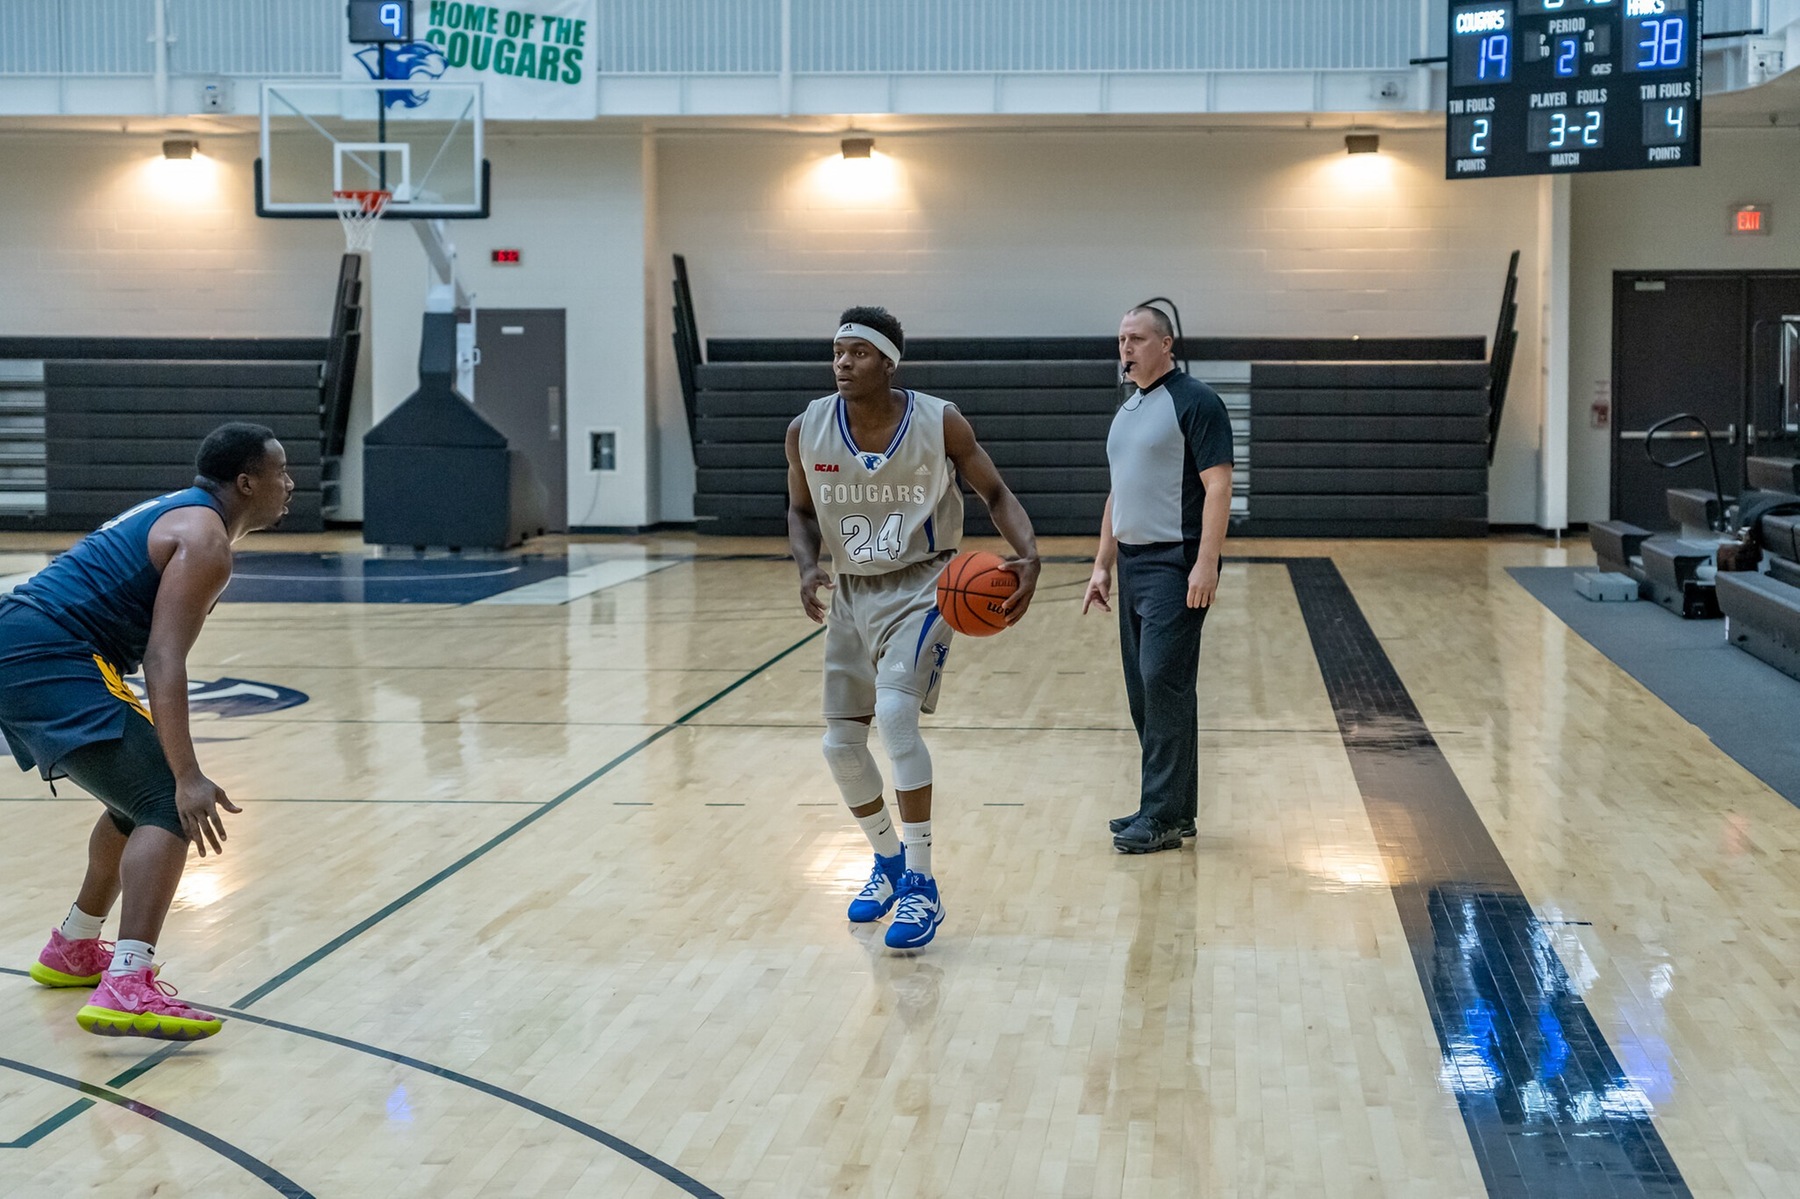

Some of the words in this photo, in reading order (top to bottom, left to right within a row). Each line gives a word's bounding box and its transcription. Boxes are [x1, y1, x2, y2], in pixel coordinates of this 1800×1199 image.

[380, 4, 400, 36] 9
[429, 0, 498, 34] HOME
[504, 11, 535, 39] OF
[541, 15, 587, 47] THE
[1456, 9, 1505, 33] COUGARS
[1549, 17, 1586, 34] PERIOD
[1540, 46, 1550, 57] TO
[1584, 42, 1594, 53] TO
[1637, 18, 1683, 68] 38
[425, 28, 584, 85] COUGARS
[1479, 35, 1508, 79] 19
[1559, 40, 1575, 73] 2
[1530, 91, 1567, 108] PLAYER
[1577, 88, 1608, 104] FOULS
[1640, 85, 1656, 100] TM
[1660, 82, 1691, 98] FOULS
[1450, 100, 1463, 114] TM
[1466, 97, 1495, 112] FOULS
[1549, 111, 1601, 147] 3-2
[1666, 106, 1683, 138] 4
[1471, 119, 1489, 152] 2
[1551, 152, 1580, 167] MATCH
[1648, 146, 1681, 161] POINTS
[1456, 158, 1486, 173] POINTS
[1737, 212, 1761, 231] EXIT
[820, 483, 926, 505] COUGARS
[840, 511, 905, 565] 24
